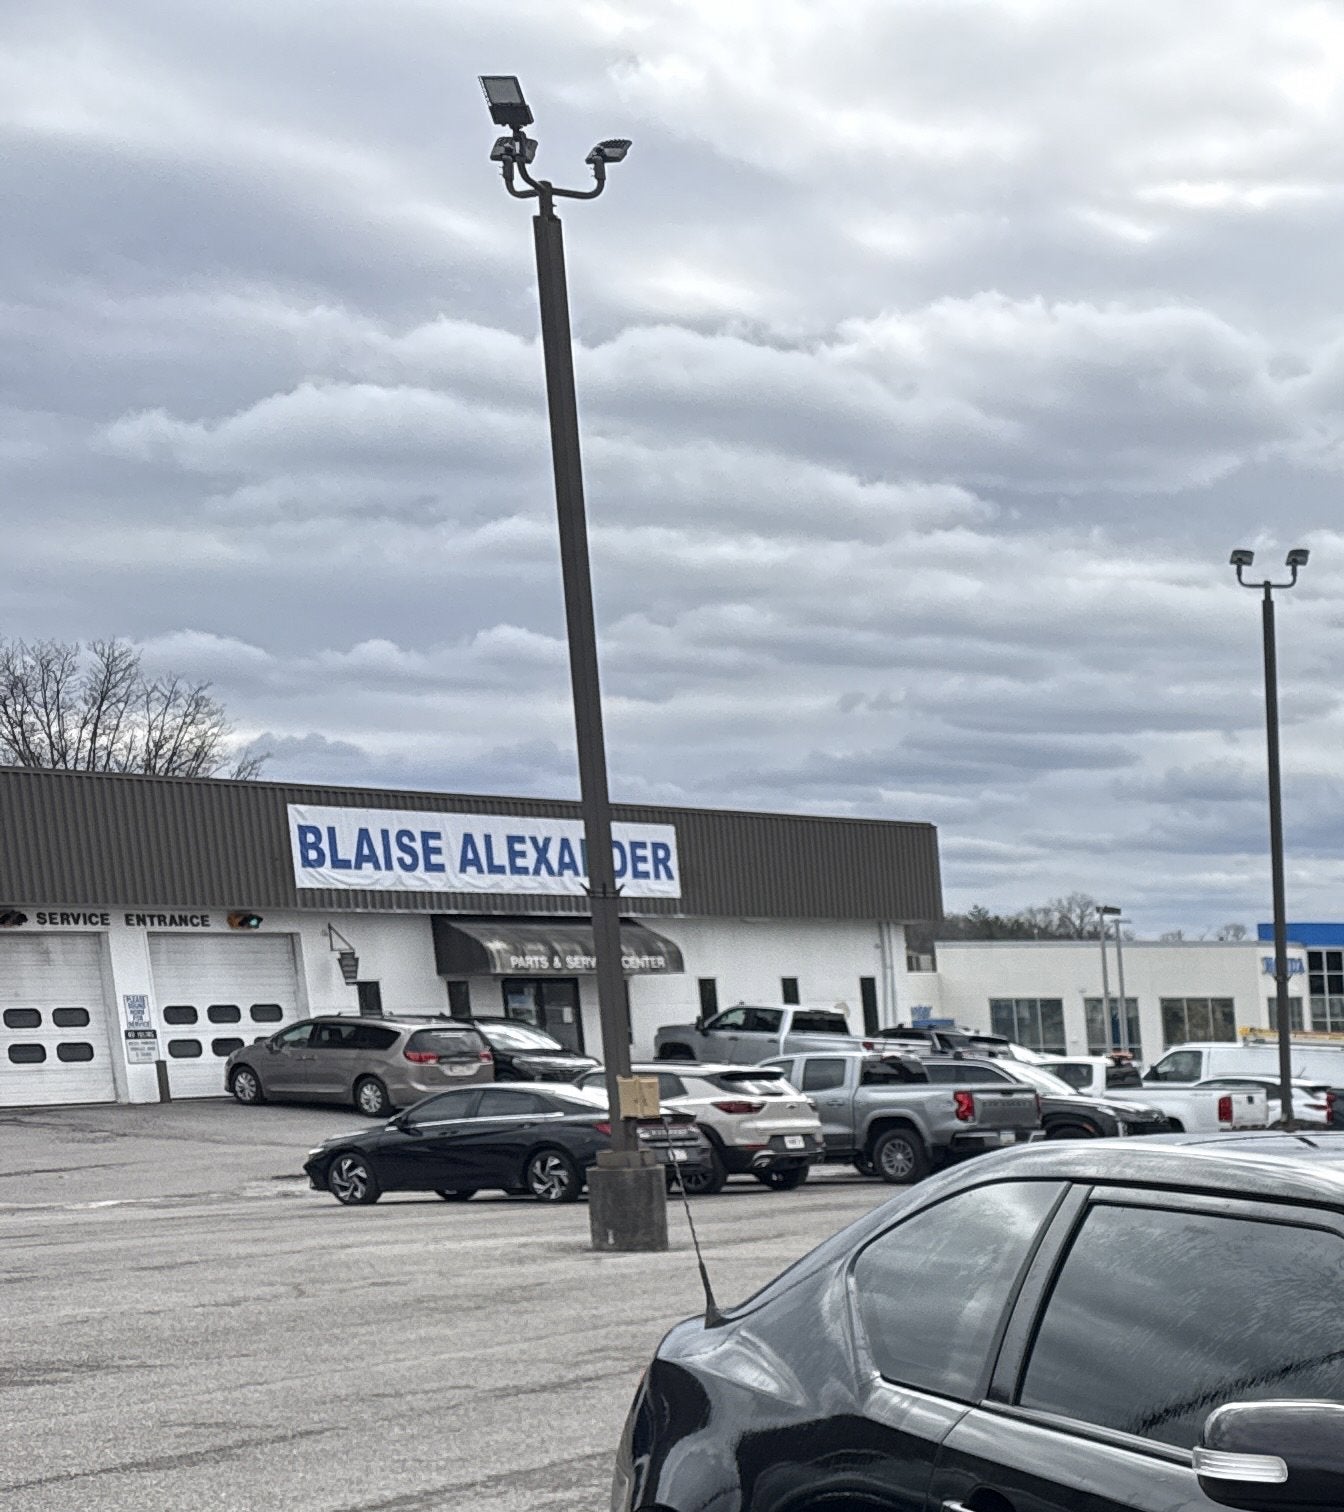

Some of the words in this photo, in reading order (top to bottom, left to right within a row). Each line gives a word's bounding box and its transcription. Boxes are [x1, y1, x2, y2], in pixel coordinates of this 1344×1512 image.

[296, 823, 446, 874] BLAISE
[459, 832, 675, 881] ALEXADER
[36, 911, 111, 927] SERVICE
[125, 913, 212, 928] ENTRANCE
[510, 955, 549, 970] PARTS
[553, 955, 562, 969] &
[565, 955, 597, 970] SERV
[620, 955, 666, 970] CENTER
